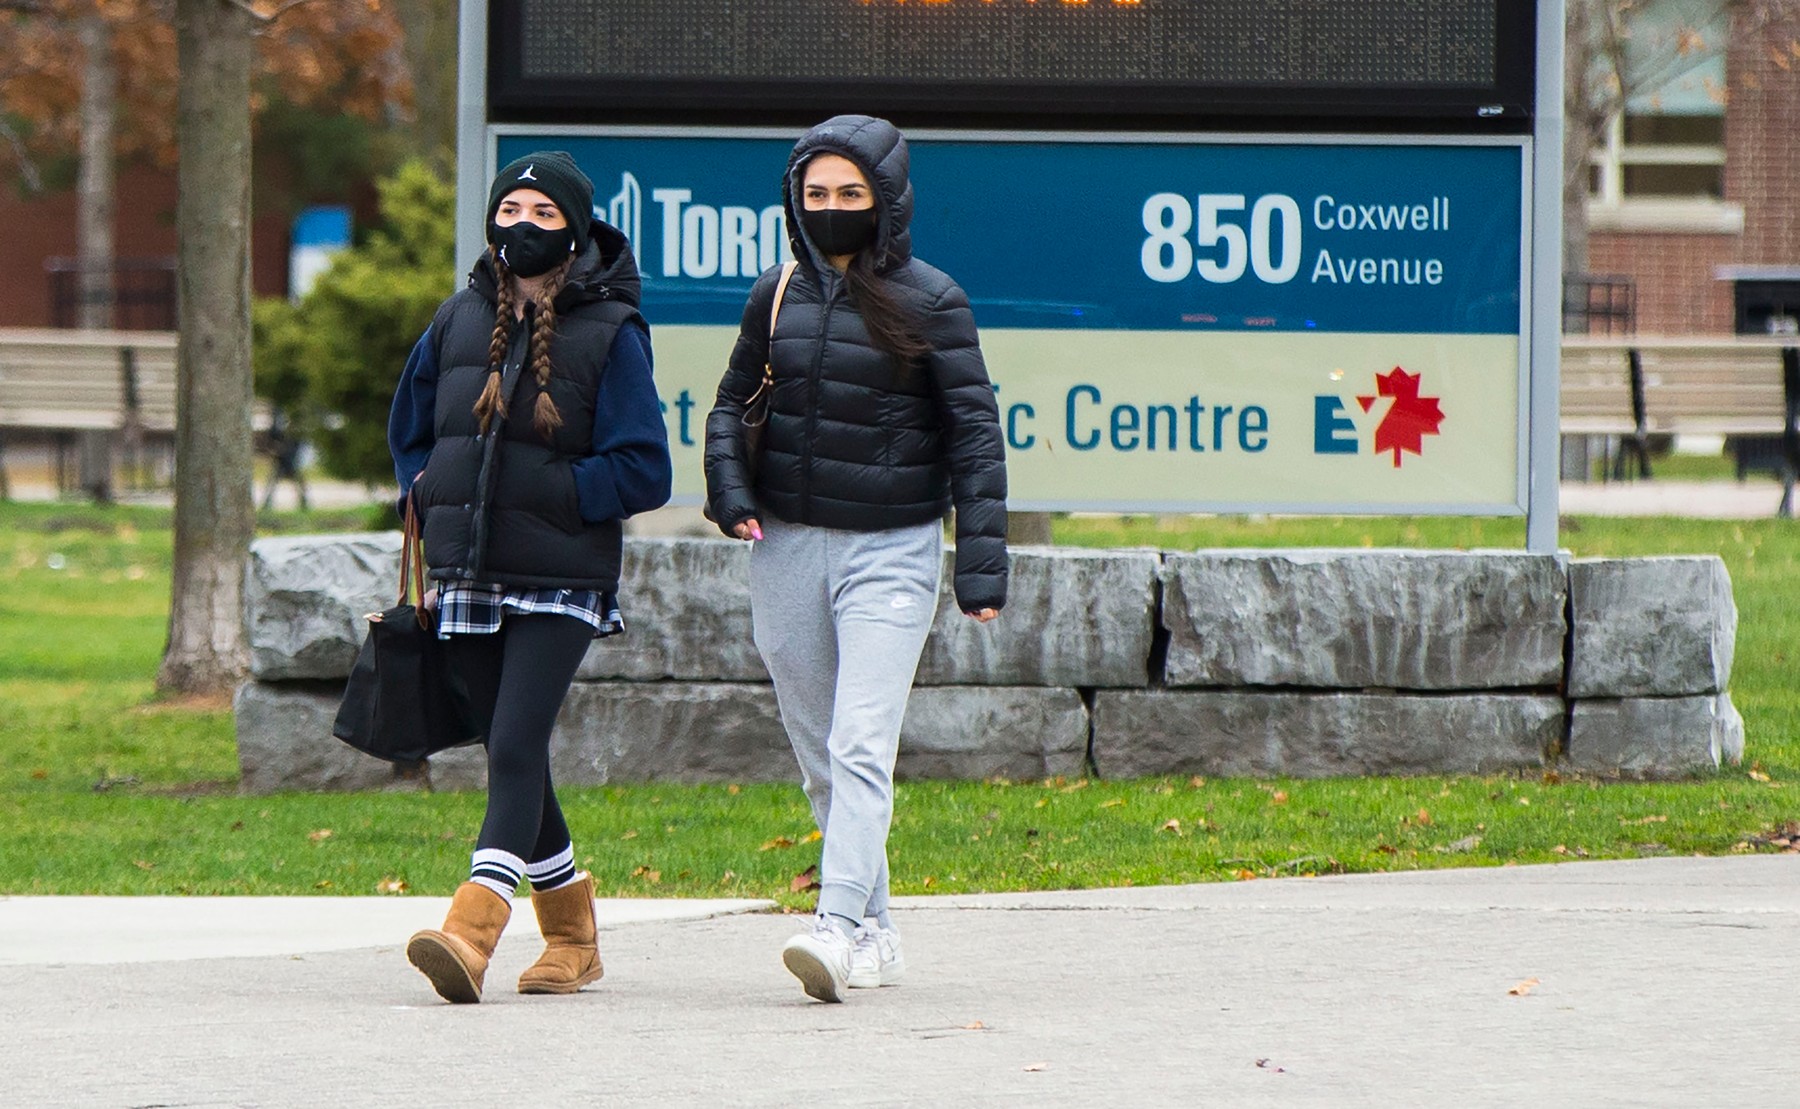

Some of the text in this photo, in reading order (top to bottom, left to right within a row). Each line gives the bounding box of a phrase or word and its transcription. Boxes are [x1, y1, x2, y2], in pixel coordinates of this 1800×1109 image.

[1141, 192, 1302, 284] 850
[1313, 195, 1449, 231] Coxwell
[1311, 249, 1444, 285] Avenue
[1066, 384, 1268, 452] Centre
